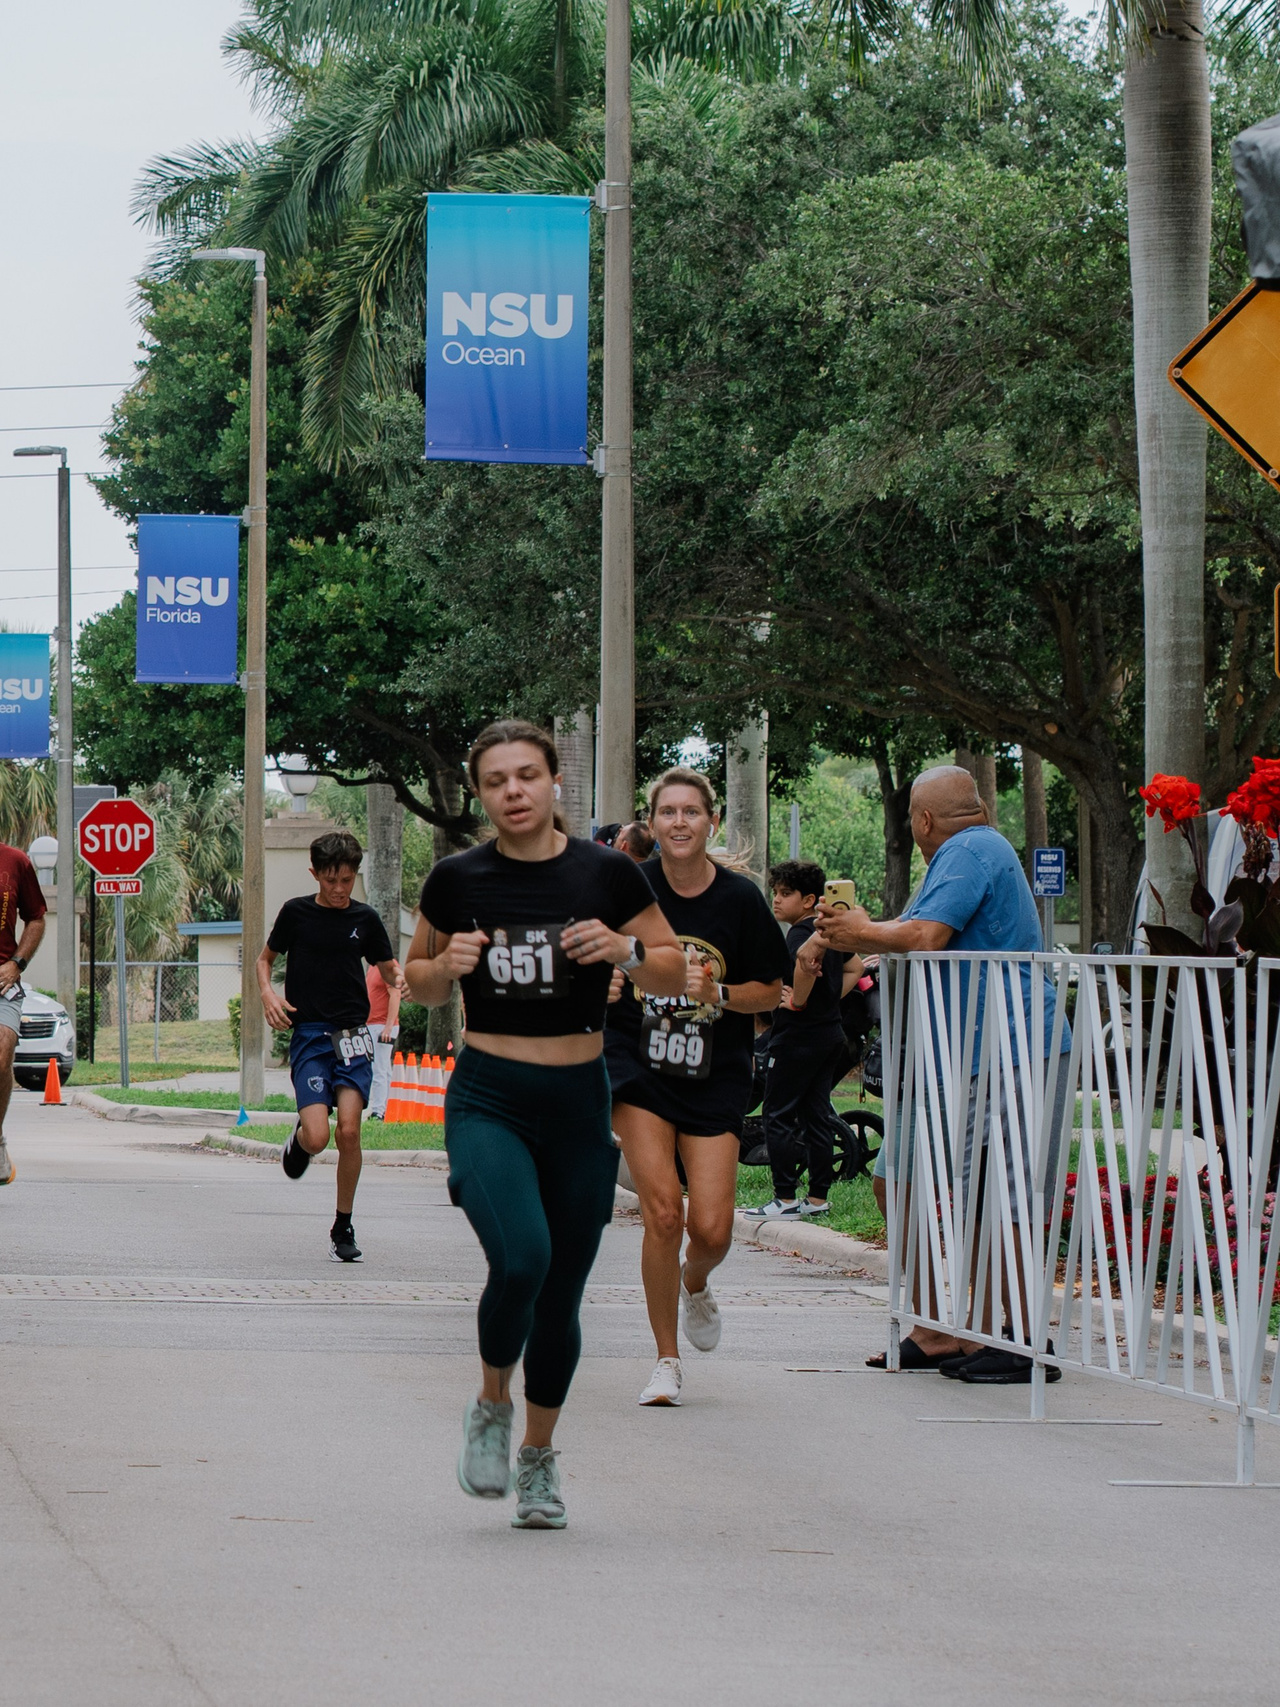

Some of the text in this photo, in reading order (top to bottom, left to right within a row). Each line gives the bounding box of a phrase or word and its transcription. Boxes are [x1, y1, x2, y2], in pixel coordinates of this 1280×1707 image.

[441, 291, 574, 339] NSU
[441, 341, 526, 366] Ocean
[146, 576, 230, 607] NSU
[146, 607, 201, 624] Florida
[83, 822, 151, 853] STOP
[99, 881, 138, 893] ALL WAY
[0, 891, 10, 931] TROPICAL
[525, 929, 548, 943] 5K
[487, 944, 554, 984] 651
[684, 1023, 700, 1035] 5K
[338, 1033, 374, 1059] 696
[648, 1029, 705, 1068] 569
